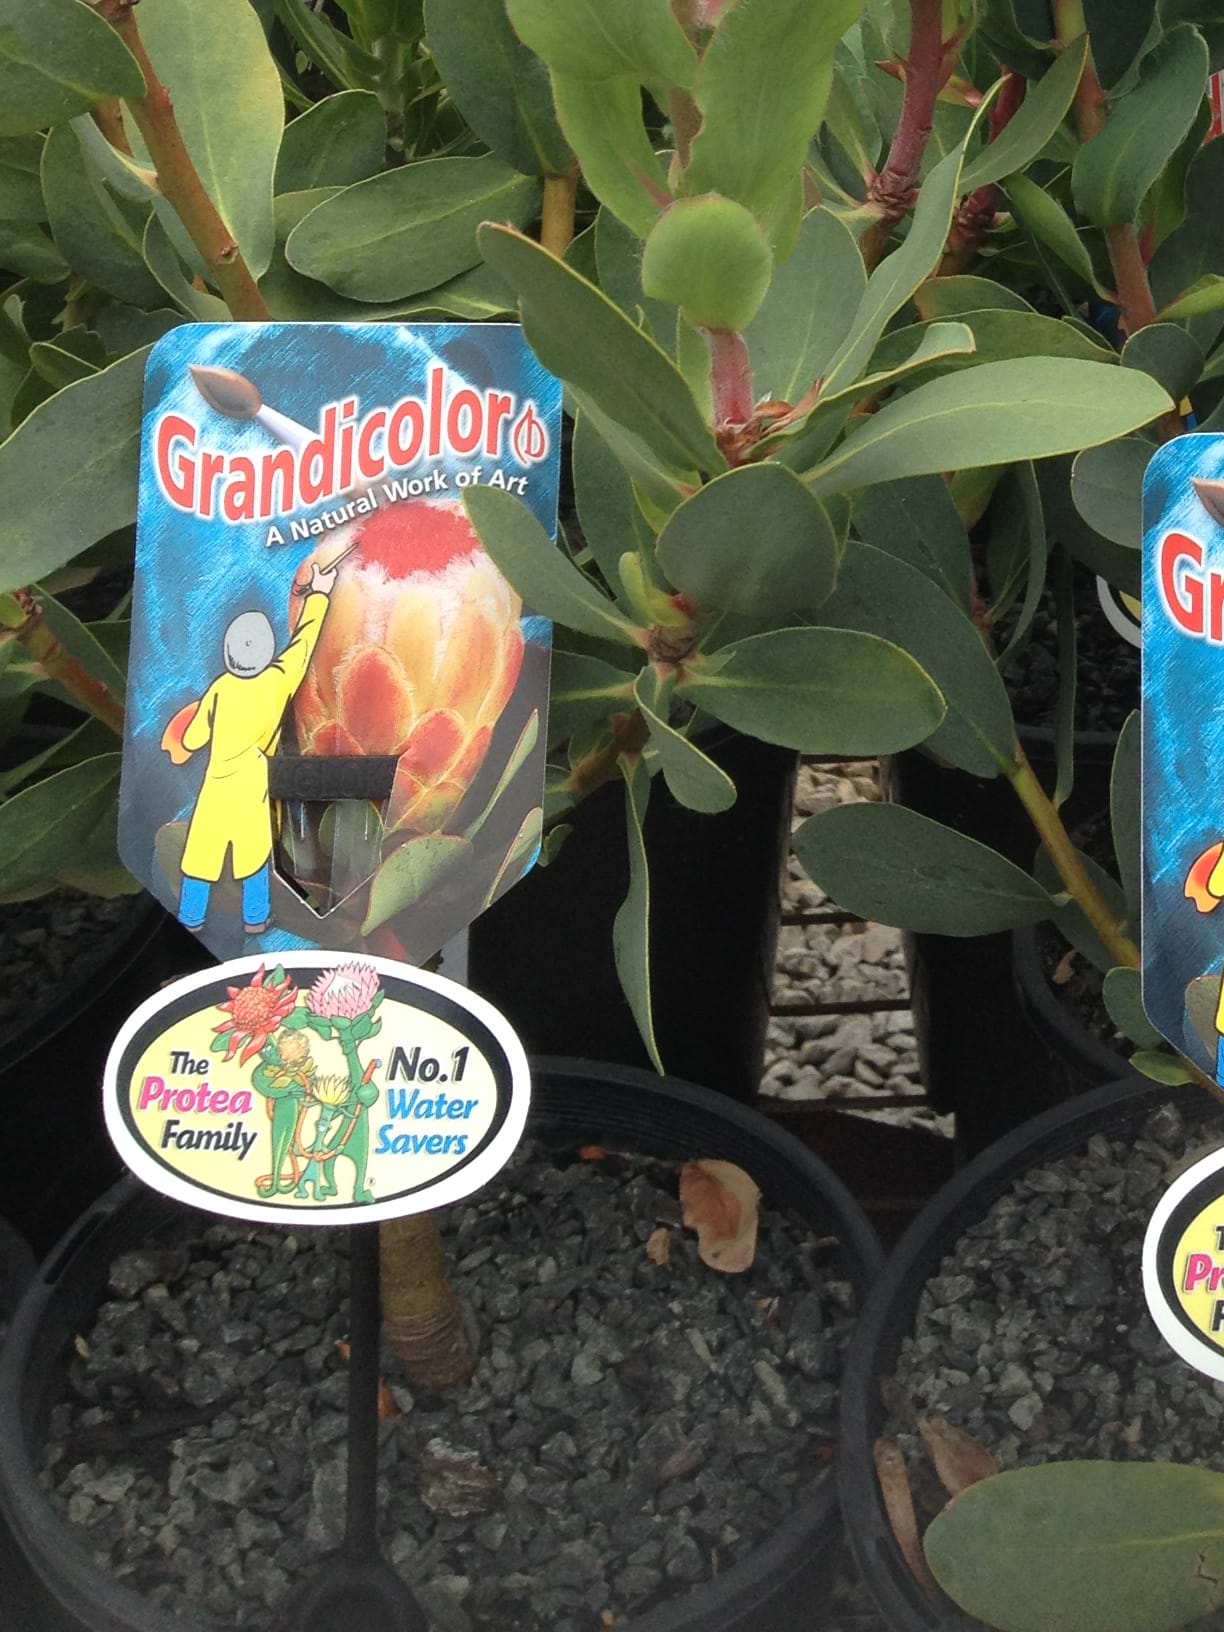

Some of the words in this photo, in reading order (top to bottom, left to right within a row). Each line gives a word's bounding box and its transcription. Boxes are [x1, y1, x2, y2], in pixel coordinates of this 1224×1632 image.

[157, 367, 513, 522] Grandicolor
[266, 526, 284, 548] A
[291, 490, 378, 540] Natural
[382, 471, 447, 501] Work
[455, 466, 482, 486] of
[489, 470, 529, 495] Art
[170, 1051, 209, 1075] The
[388, 1046, 470, 1085] No.1
[139, 1076, 253, 1115] Protea
[388, 1088, 480, 1120] Water
[162, 1119, 257, 1162] Family
[376, 1124, 469, 1156] Savers
